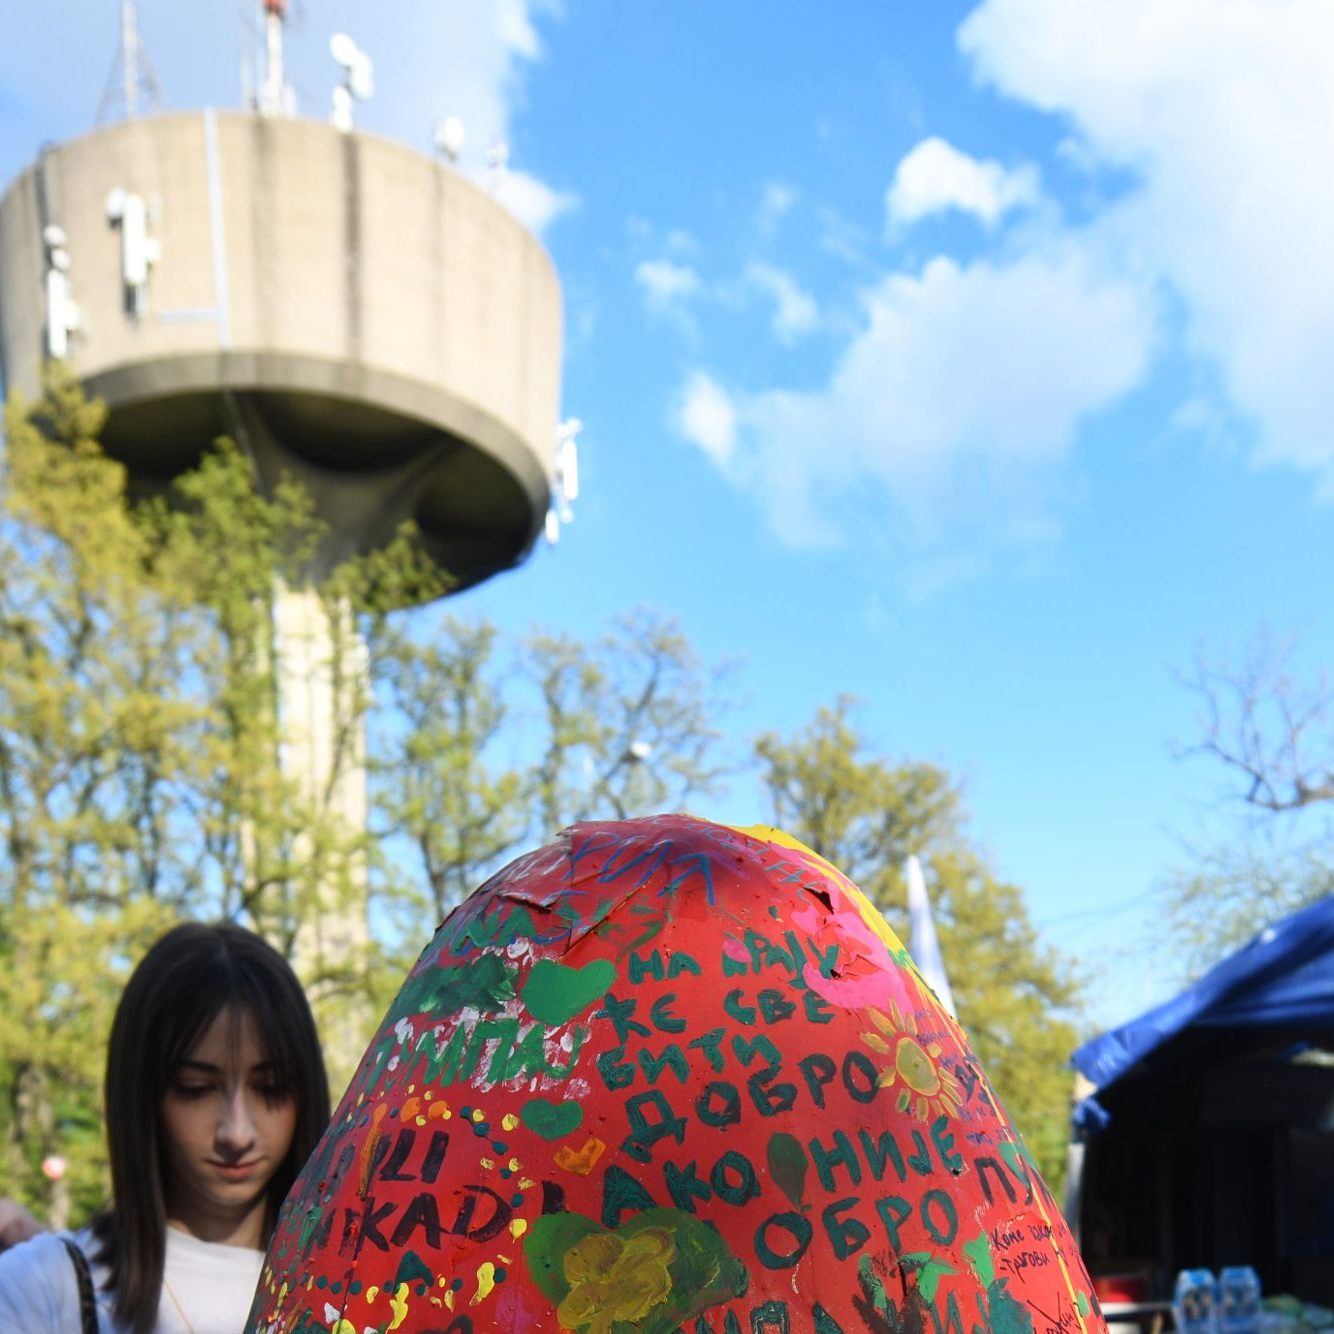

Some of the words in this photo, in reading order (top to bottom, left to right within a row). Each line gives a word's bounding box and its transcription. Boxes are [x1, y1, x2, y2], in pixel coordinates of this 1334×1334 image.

[628, 949, 702, 985] НА
[722, 987, 836, 1026] СВЕ
[595, 1027, 784, 1092] БИТИ
[619, 1049, 881, 1164] ДОБРО
[602, 1150, 762, 1229] АКО
[808, 1115, 966, 1194] НИЈЕ
[747, 1187, 959, 1272] ОБРО
